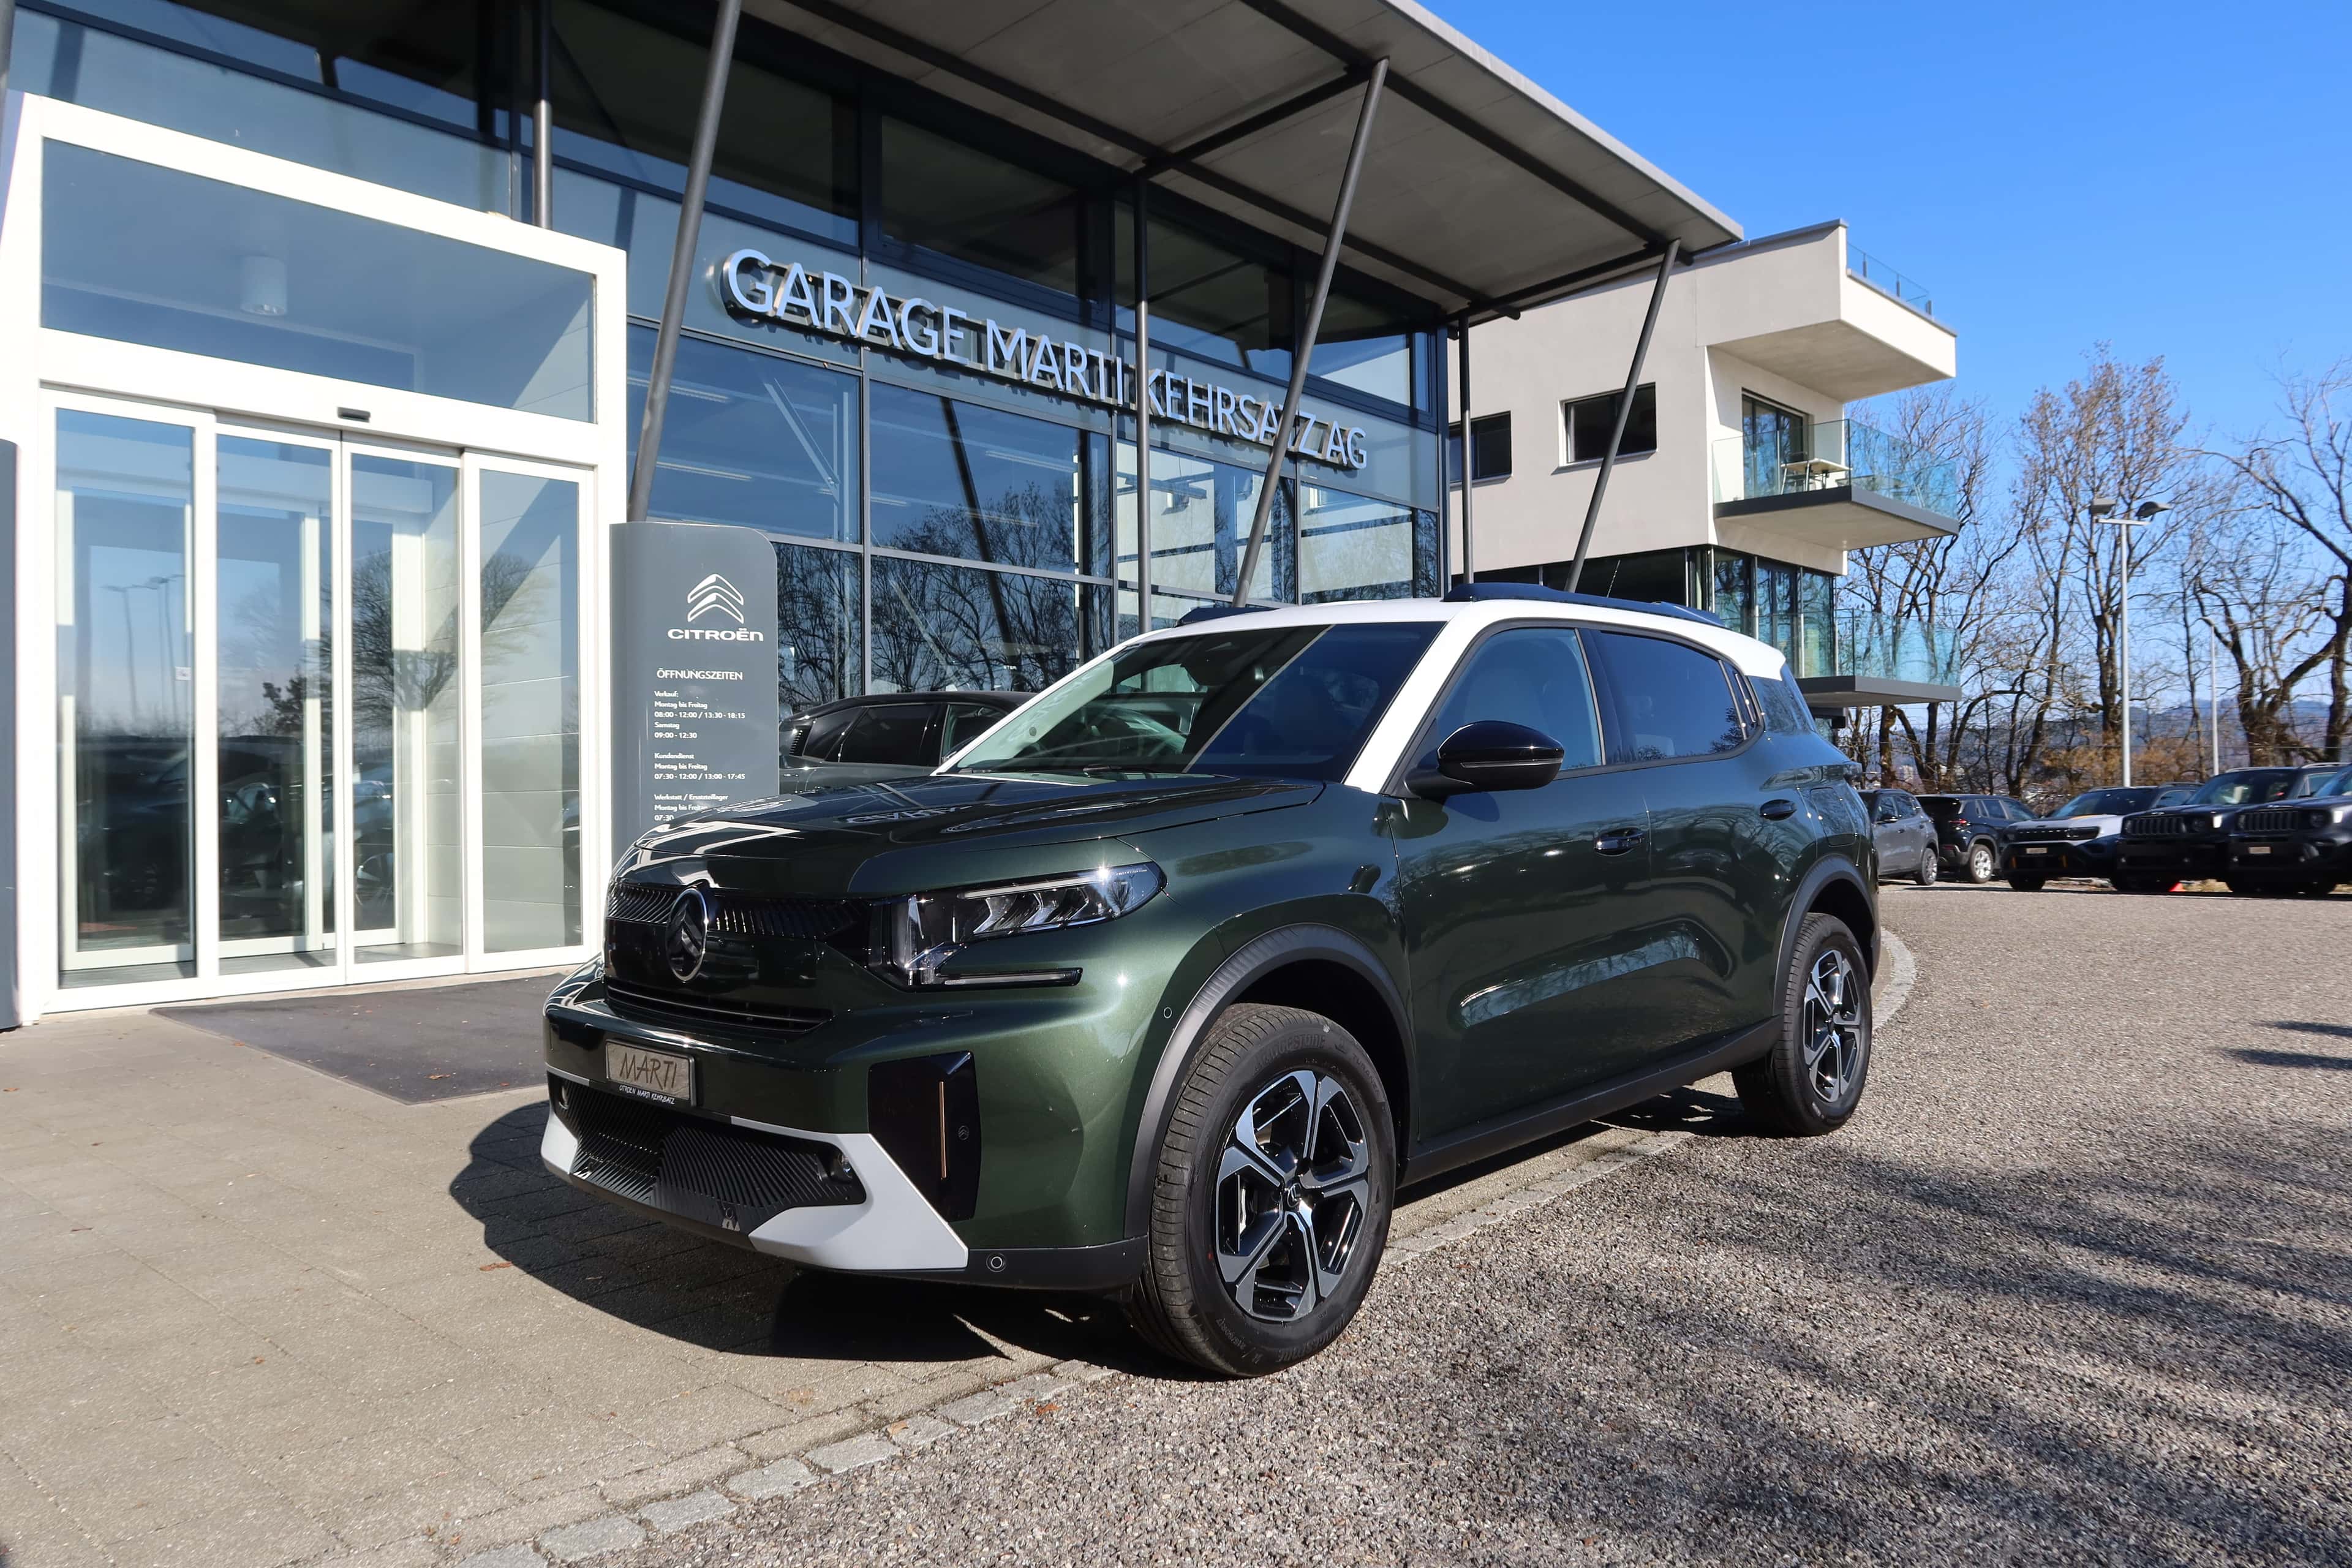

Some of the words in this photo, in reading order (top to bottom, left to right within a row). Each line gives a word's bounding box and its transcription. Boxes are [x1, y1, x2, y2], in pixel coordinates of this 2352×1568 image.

[724, 248, 970, 366] GARAGE
[986, 317, 1124, 407] MARTI
[1148, 368, 1318, 458] KEHRSAZ
[1326, 420, 1367, 470] AG
[667, 628, 764, 642] CITROËN
[657, 668, 743, 680] ÖFFNUNGSZEITEN
[619, 1053, 677, 1090] MARTI
